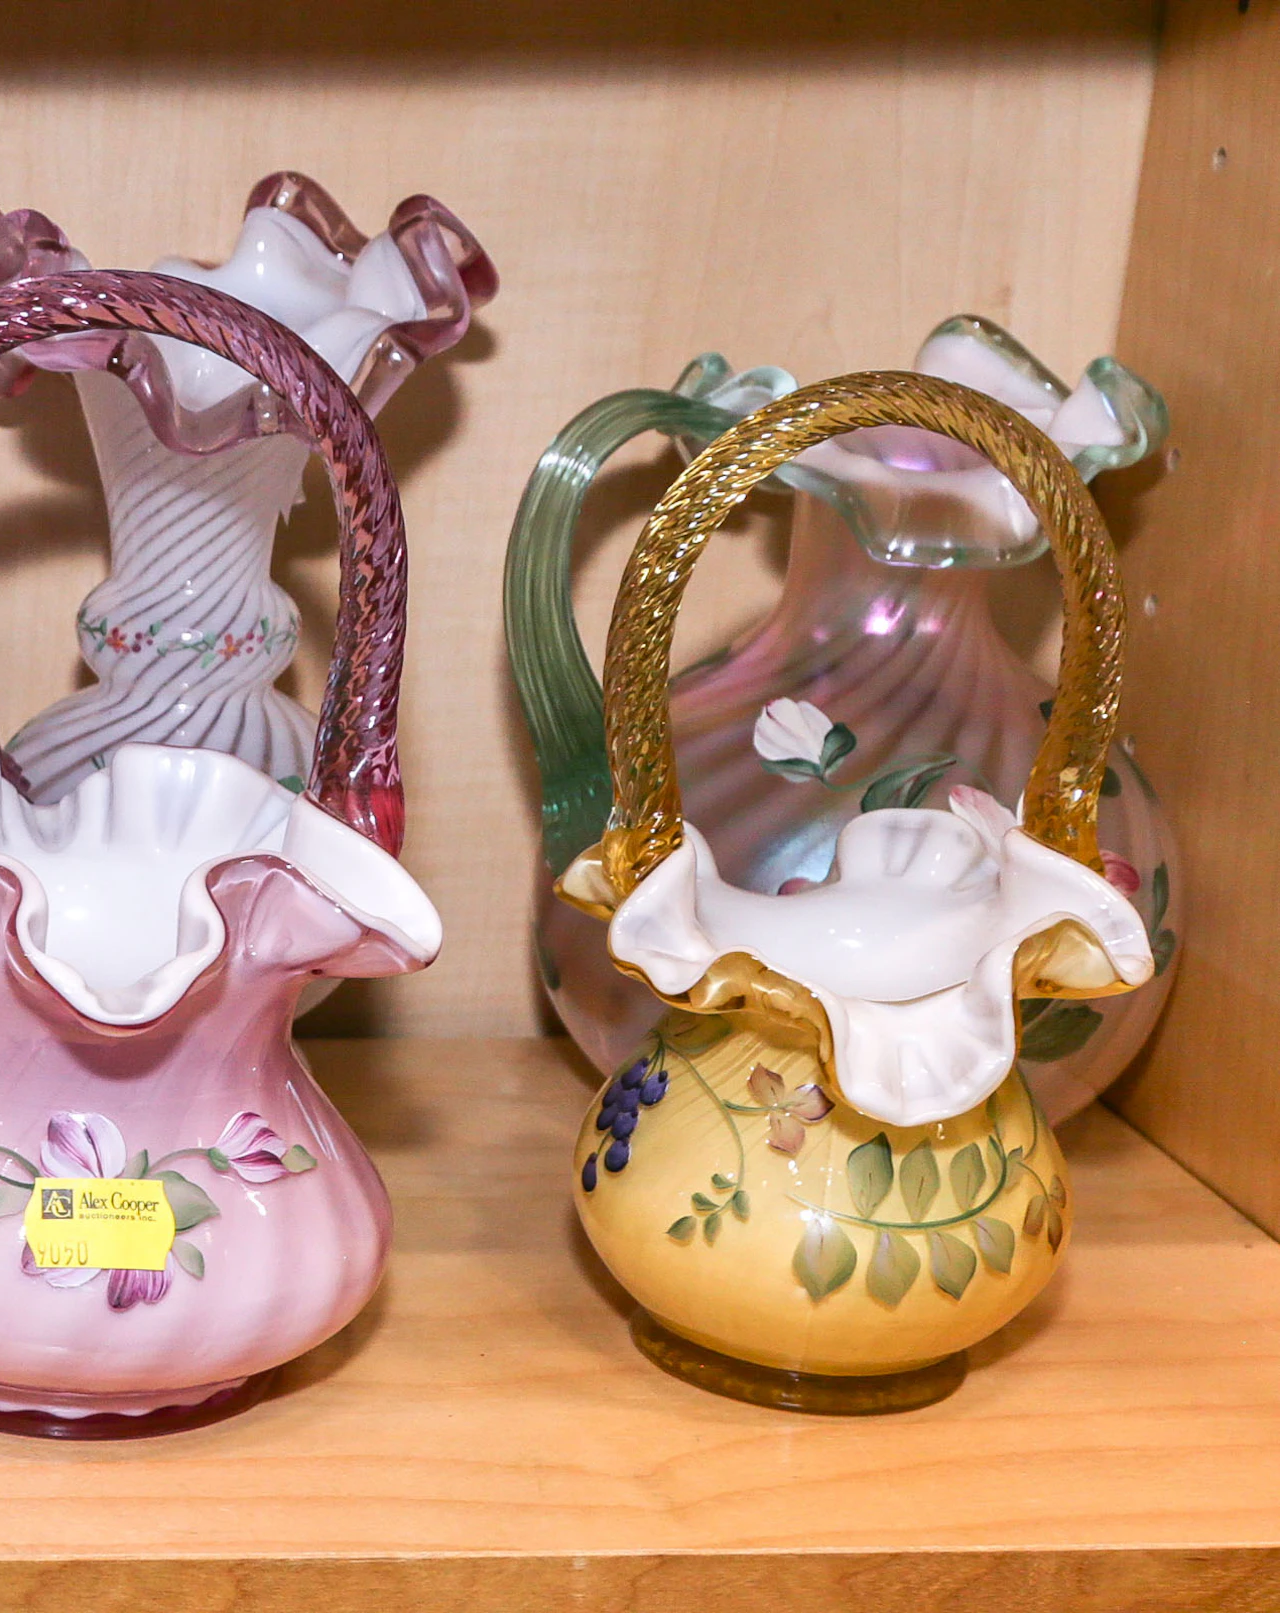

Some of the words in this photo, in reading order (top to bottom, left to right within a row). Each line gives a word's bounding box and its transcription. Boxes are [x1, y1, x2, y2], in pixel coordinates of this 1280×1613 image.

[79, 1192, 108, 1210] Alex
[111, 1192, 159, 1214] Cooper
[79, 1213, 135, 1221] auctioneers
